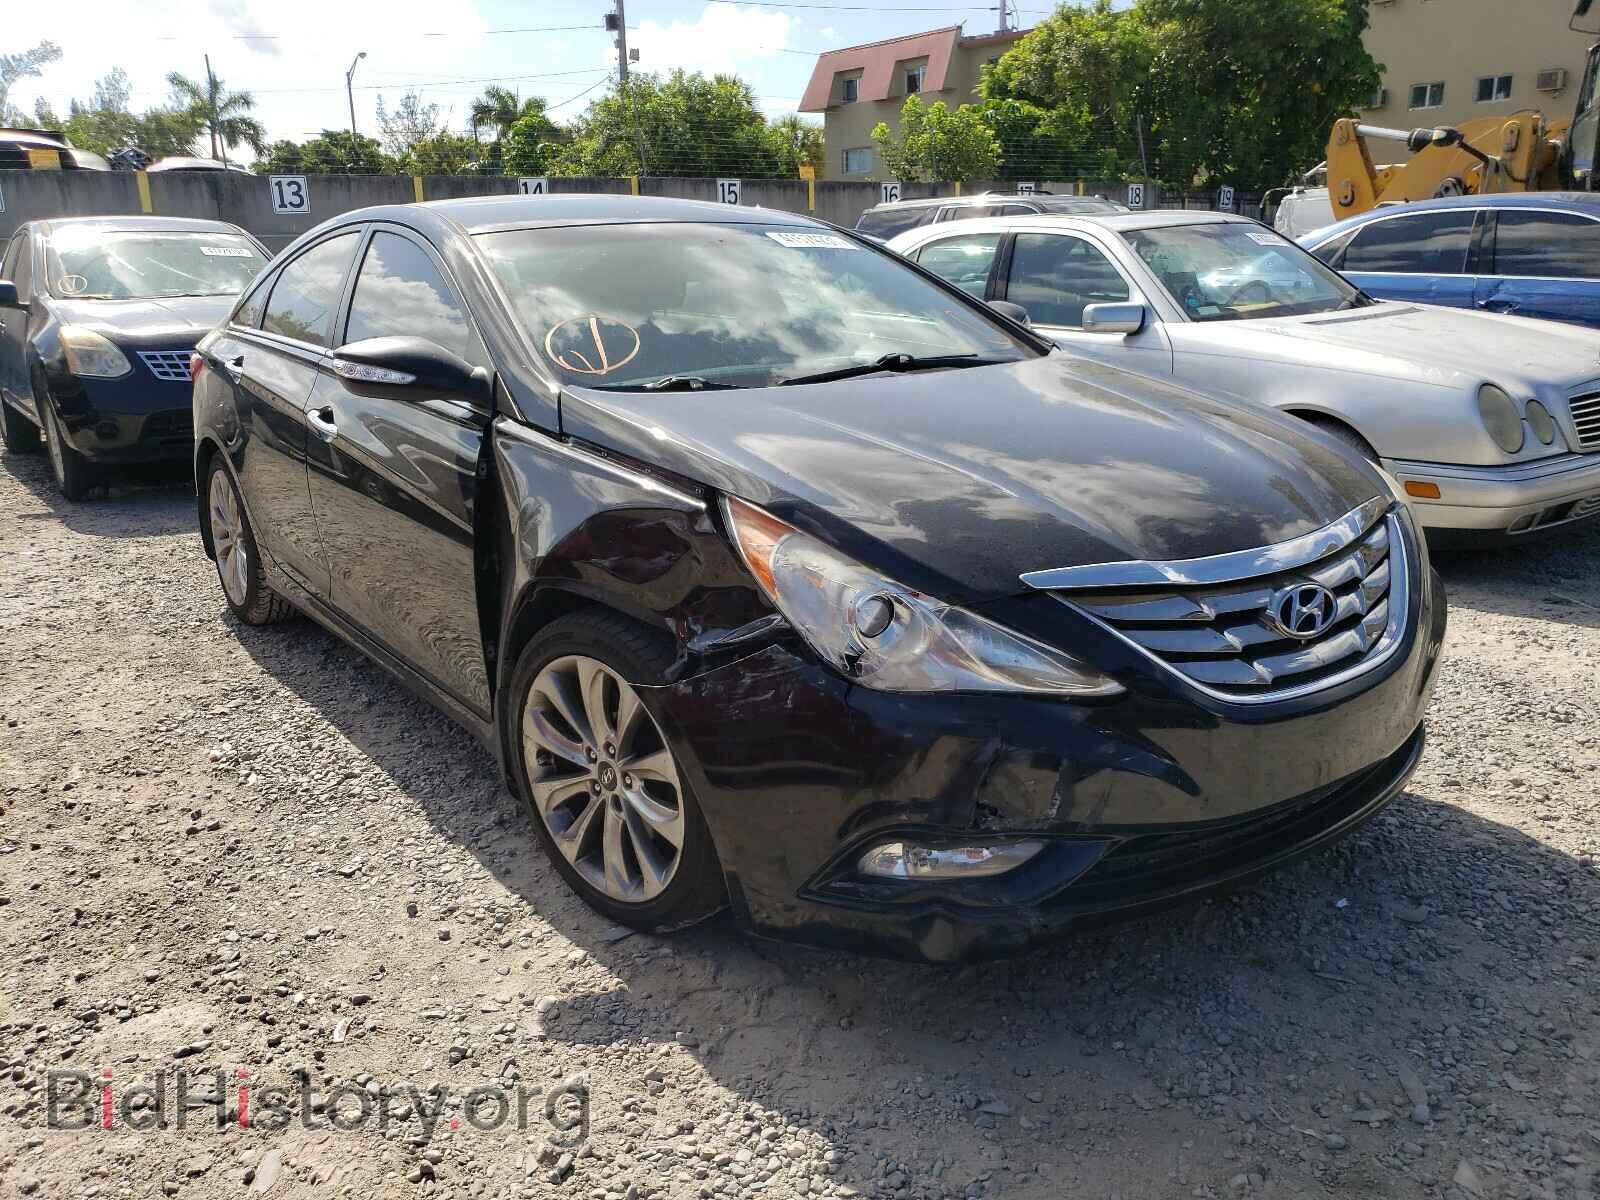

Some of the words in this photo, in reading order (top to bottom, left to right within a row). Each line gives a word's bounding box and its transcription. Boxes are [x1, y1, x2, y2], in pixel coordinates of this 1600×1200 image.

[274, 180, 305, 209] 13
[719, 182, 738, 205] 15
[883, 185, 898, 203] 16
[1129, 186, 1140, 205] 18
[1222, 188, 1233, 206] 19
